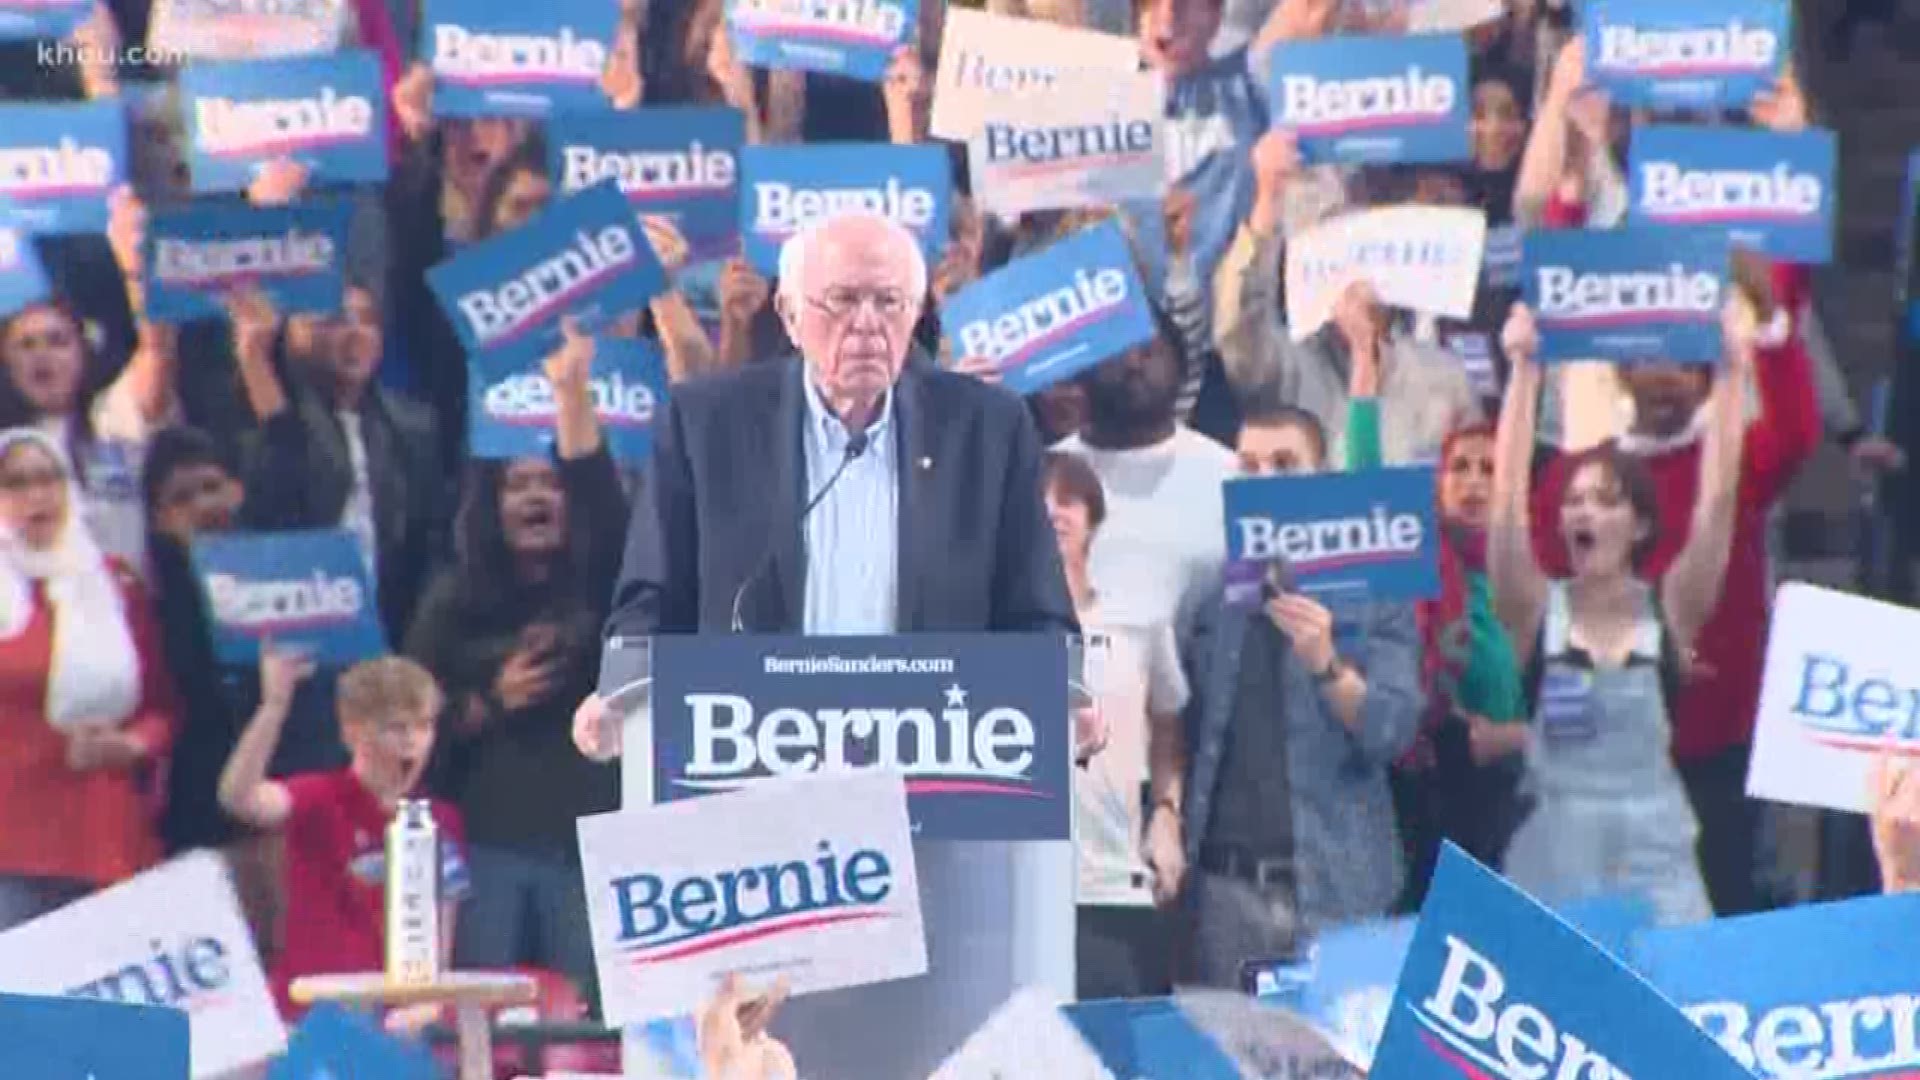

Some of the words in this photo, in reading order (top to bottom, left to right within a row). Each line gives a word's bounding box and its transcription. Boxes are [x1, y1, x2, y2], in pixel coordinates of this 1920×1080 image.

[434, 24, 606, 72] Bernie
[1598, 20, 1778, 66] Bernie
[1282, 66, 1456, 119] Bernie
[984, 110, 1152, 163] Bernie
[1640, 161, 1822, 214] Bernie
[457, 224, 634, 346] Bernie
[960, 266, 1127, 358] Bernie
[1536, 264, 1720, 314] Bernie
[1238, 508, 1422, 562] Bernie
[763, 654, 954, 674] BernieSanders.com
[1789, 653, 1920, 738] Be
[683, 682, 1037, 777] Bernie
[609, 839, 893, 943] Bernie
[1425, 935, 1632, 1080] Ber
[1680, 994, 1920, 1080] Ber
